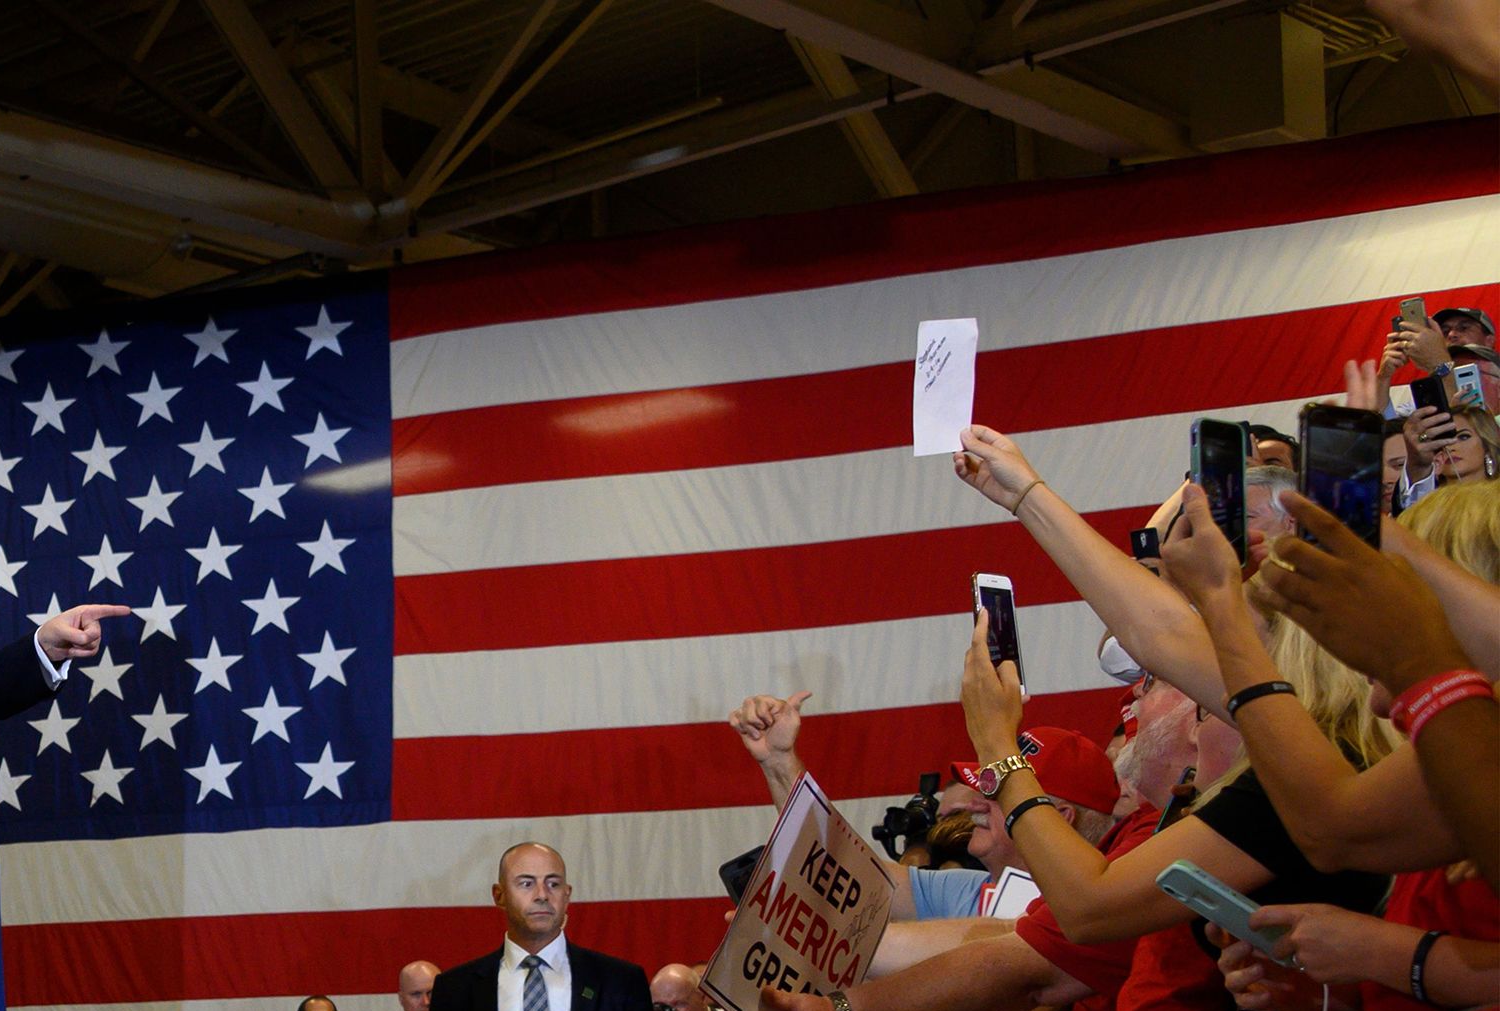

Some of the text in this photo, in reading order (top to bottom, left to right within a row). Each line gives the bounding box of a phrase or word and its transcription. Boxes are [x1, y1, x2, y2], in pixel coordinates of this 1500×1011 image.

[800, 840, 861, 914] KEEP
[749, 871, 861, 989] AMERICA
[743, 941, 823, 997] GRE
